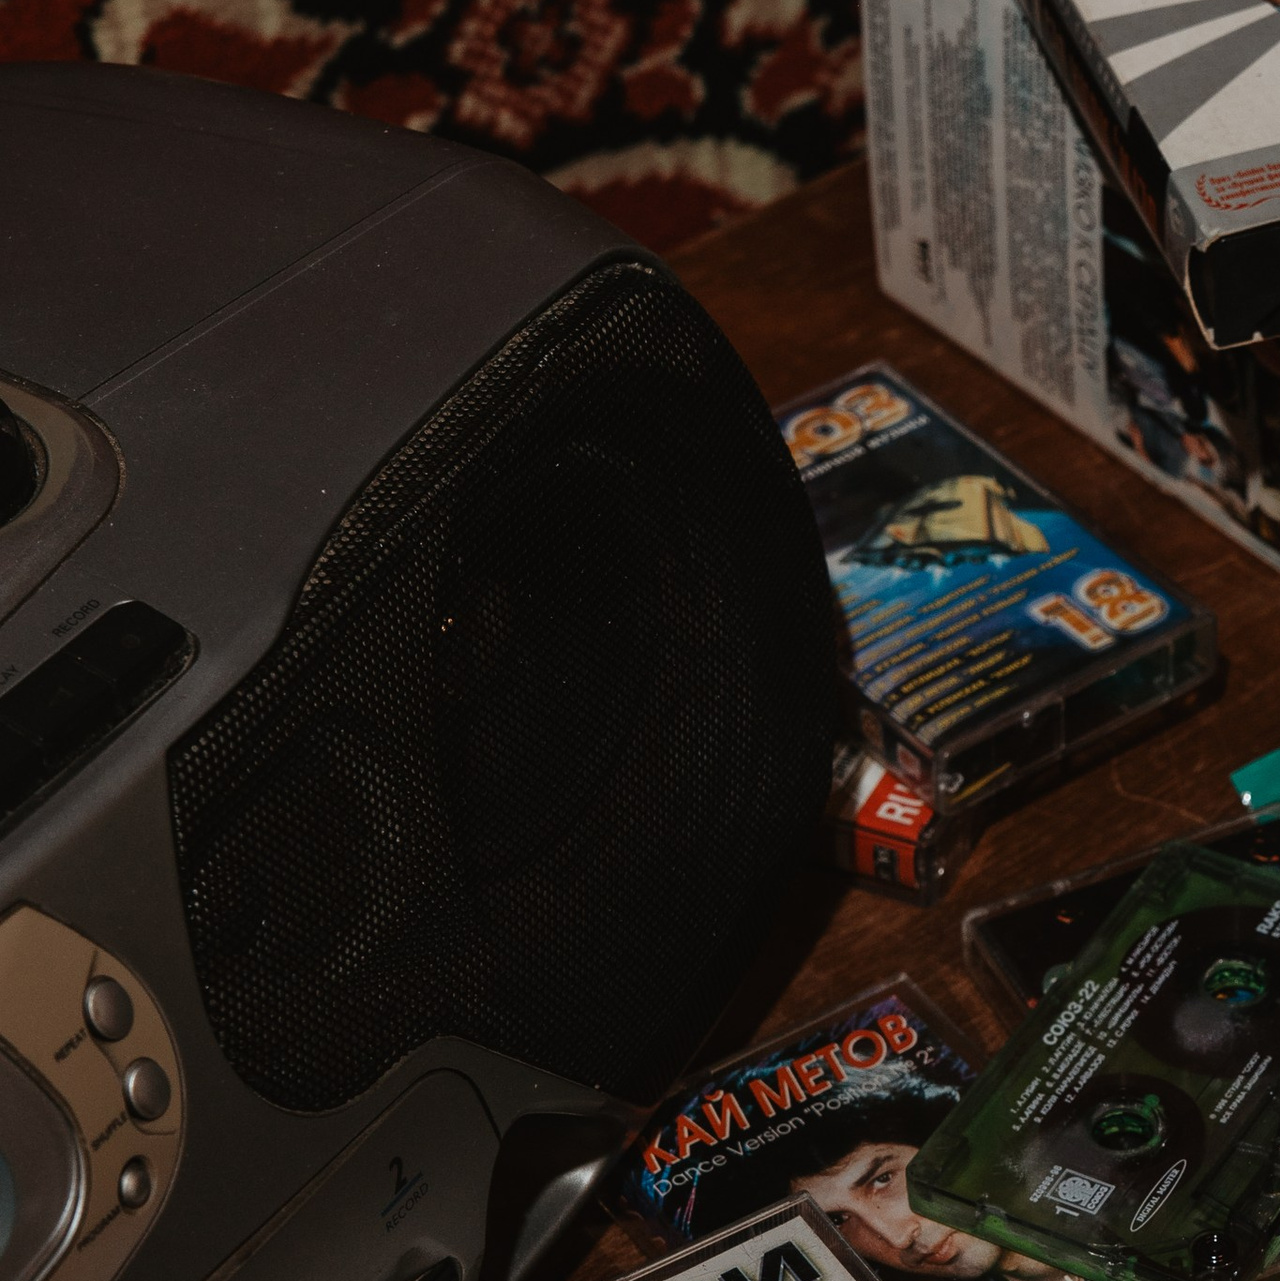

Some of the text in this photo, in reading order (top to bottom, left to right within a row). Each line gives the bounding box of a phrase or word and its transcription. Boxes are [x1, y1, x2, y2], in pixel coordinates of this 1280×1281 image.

[51, 598, 101, 639] RECORD
[1030, 571, 1169, 652] 18
[1042, 979, 1100, 1047] СОЮЗ-22
[641, 1012, 919, 1176] КАЙ МЕТОВ
[388, 1156, 409, 1196] 2
[653, 1153, 729, 1199] Dance
[725, 1115, 807, 1158] Version
[384, 1181, 430, 1234] RECORD
[1086, 1186, 1110, 1210] СОЮЗ
[1136, 1168, 1181, 1223] DIGITAL MASTER
